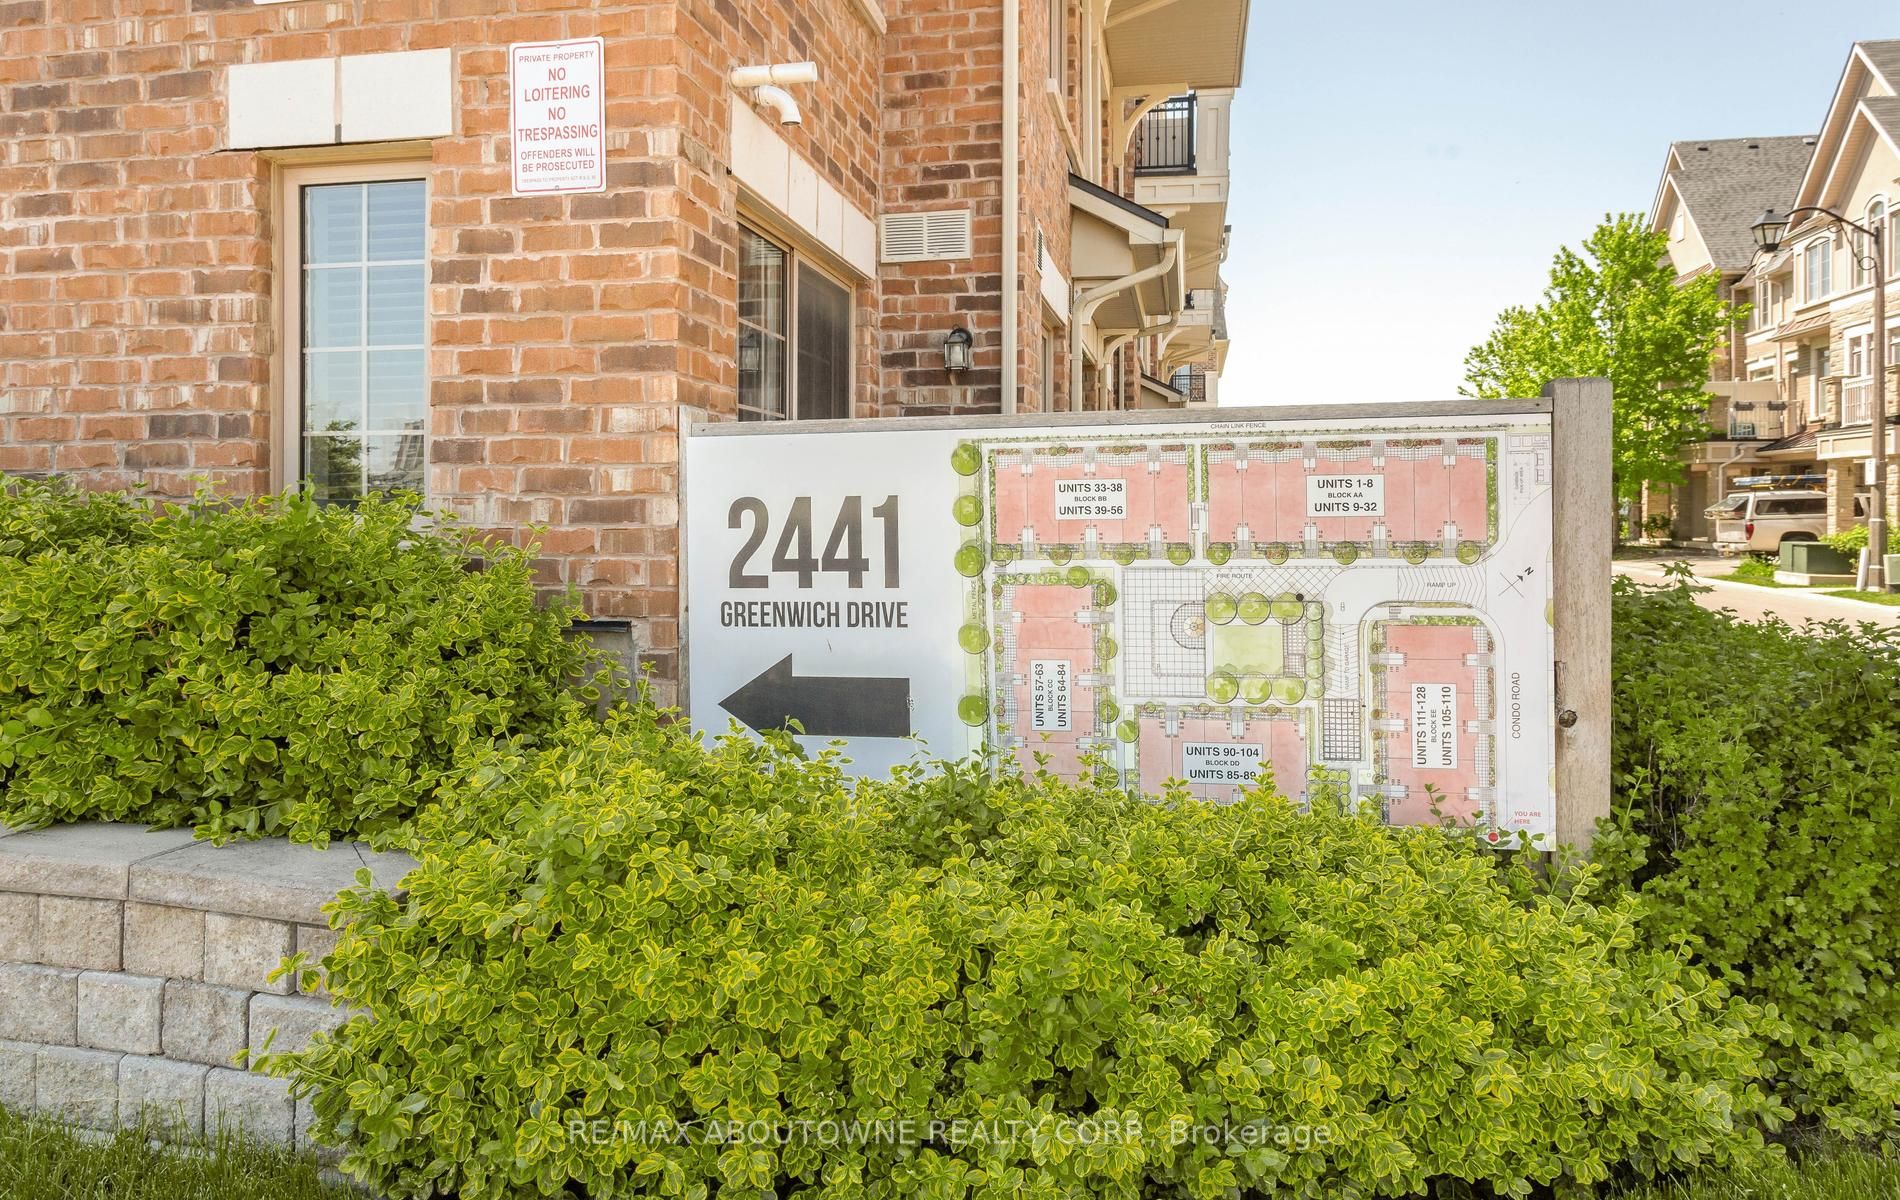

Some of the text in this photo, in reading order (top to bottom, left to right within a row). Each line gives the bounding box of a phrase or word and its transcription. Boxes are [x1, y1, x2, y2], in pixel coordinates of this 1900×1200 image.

[519, 51, 594, 63] PRIVATE PROPERTY
[548, 67, 566, 81] NO
[524, 85, 590, 102] LOITERING
[548, 107, 566, 120] NO
[518, 124, 598, 142] TRESPASSING
[520, 148, 596, 160] OFFENDERS WILL
[522, 160, 595, 173] BE PROSECUTED
[1059, 483, 1123, 492] UNITS 33-38
[1317, 479, 1374, 488] UNITS 1-8
[1059, 506, 1123, 515] UNITS 39-56
[1314, 502, 1377, 512] UNITS 9-32
[728, 495, 900, 589] 2441
[1524, 566, 1534, 575] N
[720, 601, 908, 628] GREENWICH DRIVE
[1048, 679, 1053, 689] CC
[1035, 664, 1044, 727] UNITS 57-63
[1057, 664, 1067, 727] UNITS 64-84
[1512, 672, 1520, 739] CONDO ROAD
[1431, 709, 1436, 718] EE
[1416, 686, 1427, 765] UNITS 111-128
[1442, 686, 1452, 766] UNITS 105-110
[1186, 746, 1259, 757] UNITS 90-104
[1190, 769, 1256, 780] UNITS 85-89
